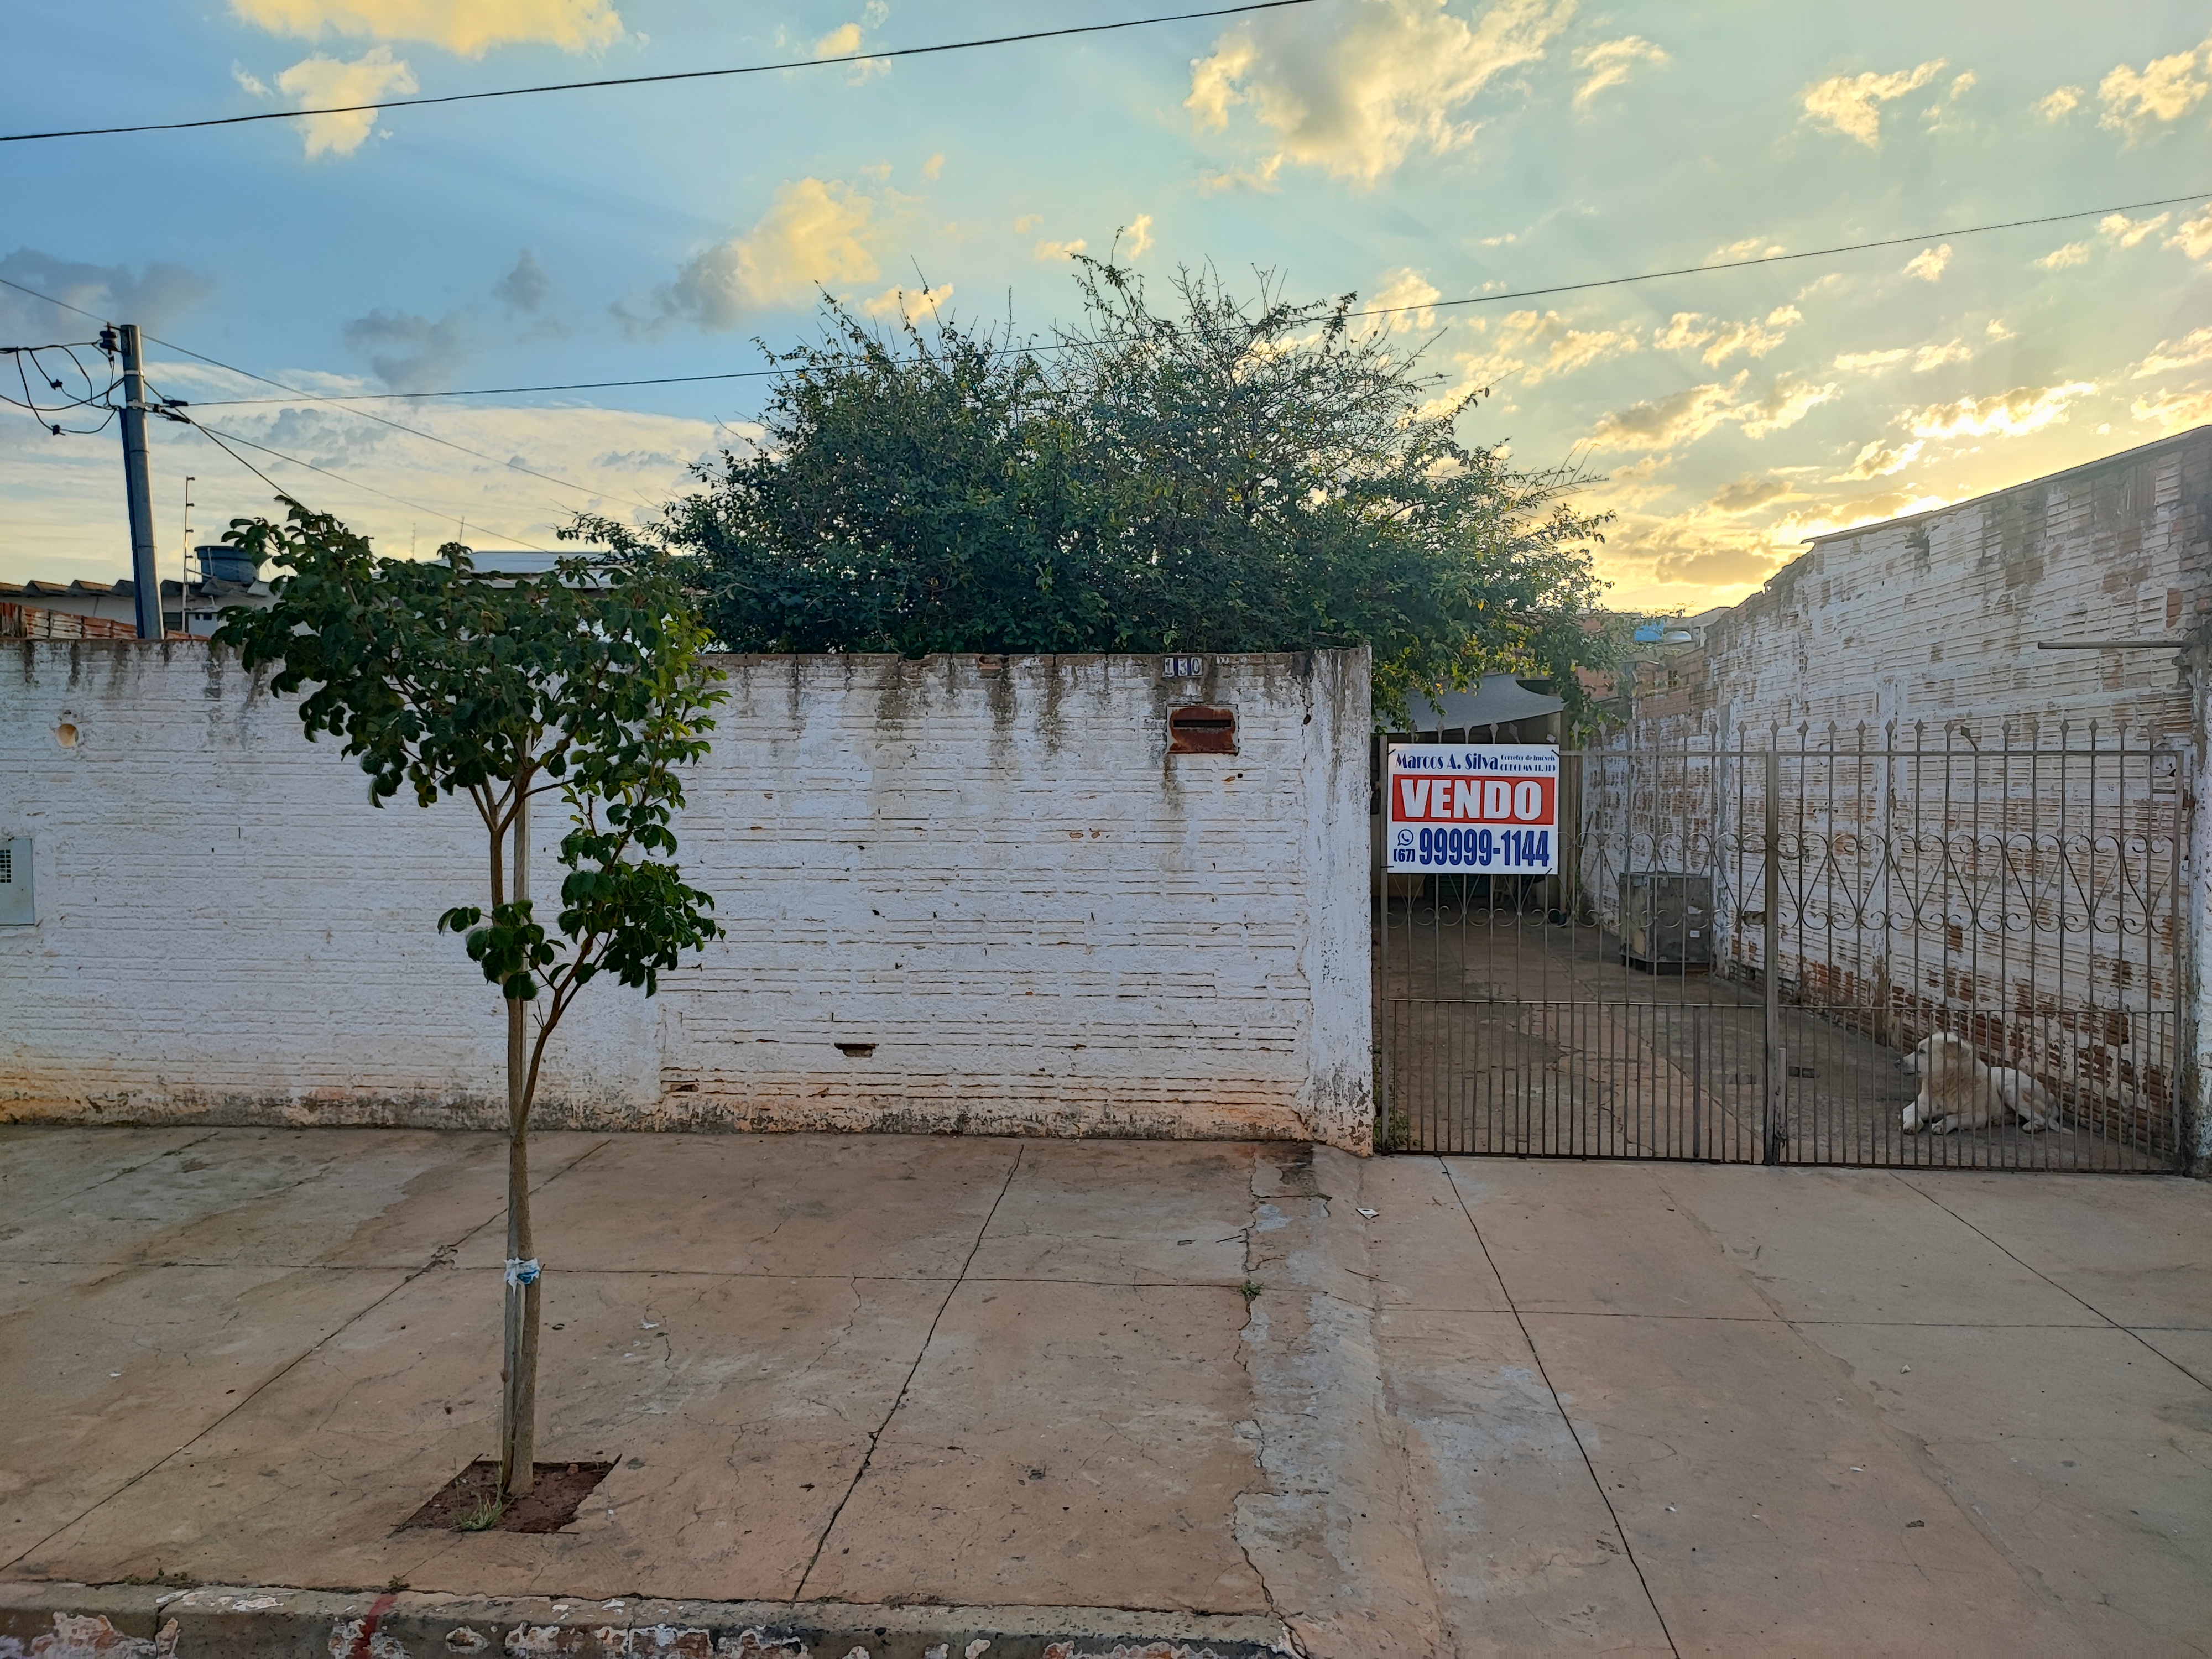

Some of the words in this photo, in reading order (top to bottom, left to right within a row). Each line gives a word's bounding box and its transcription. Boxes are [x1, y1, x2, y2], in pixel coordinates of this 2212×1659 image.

[1165, 659, 1201, 675] 130
[1395, 753, 1443, 769] Marcos
[1446, 753, 1461, 769] A.
[1465, 753, 1498, 770] Silva
[1400, 779, 1542, 821] VENDO
[1394, 848, 1415, 862] (67)
[1419, 828, 1549, 867] 99999-1144
